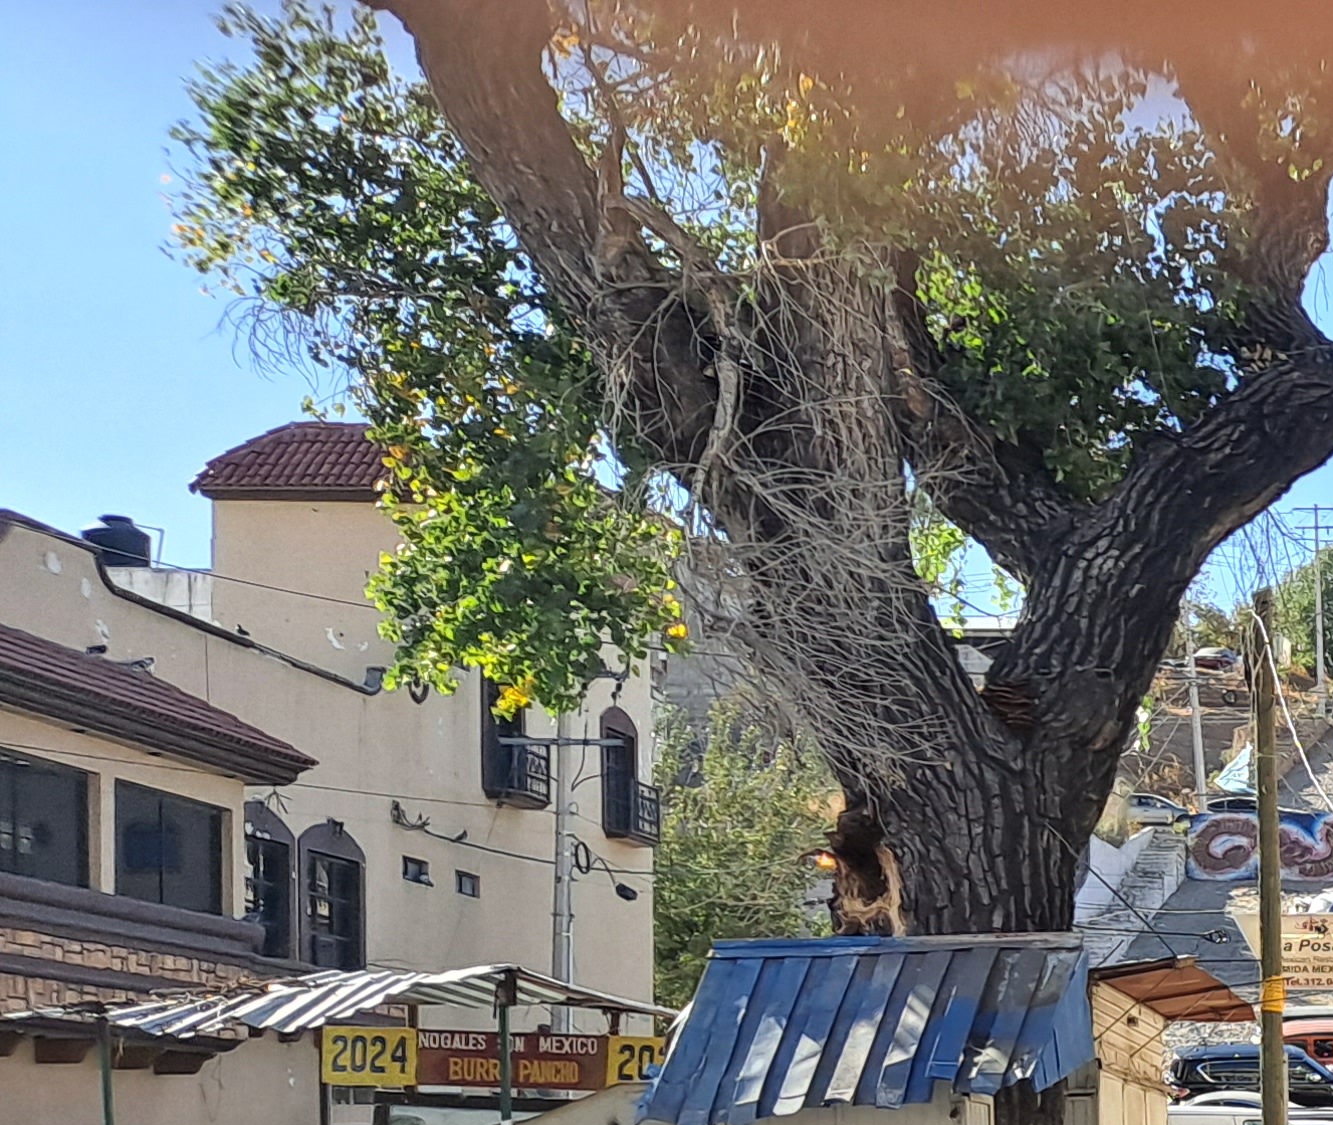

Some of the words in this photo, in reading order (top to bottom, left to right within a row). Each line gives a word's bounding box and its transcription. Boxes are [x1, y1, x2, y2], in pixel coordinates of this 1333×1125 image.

[1283, 941, 1293, 952] a
[331, 1035, 408, 1075] 2024
[418, 1032, 486, 1050] NOGALES
[540, 1033, 598, 1055] MEXICO
[449, 1056, 500, 1081] BURR
[519, 1059, 579, 1084] PANCHO
